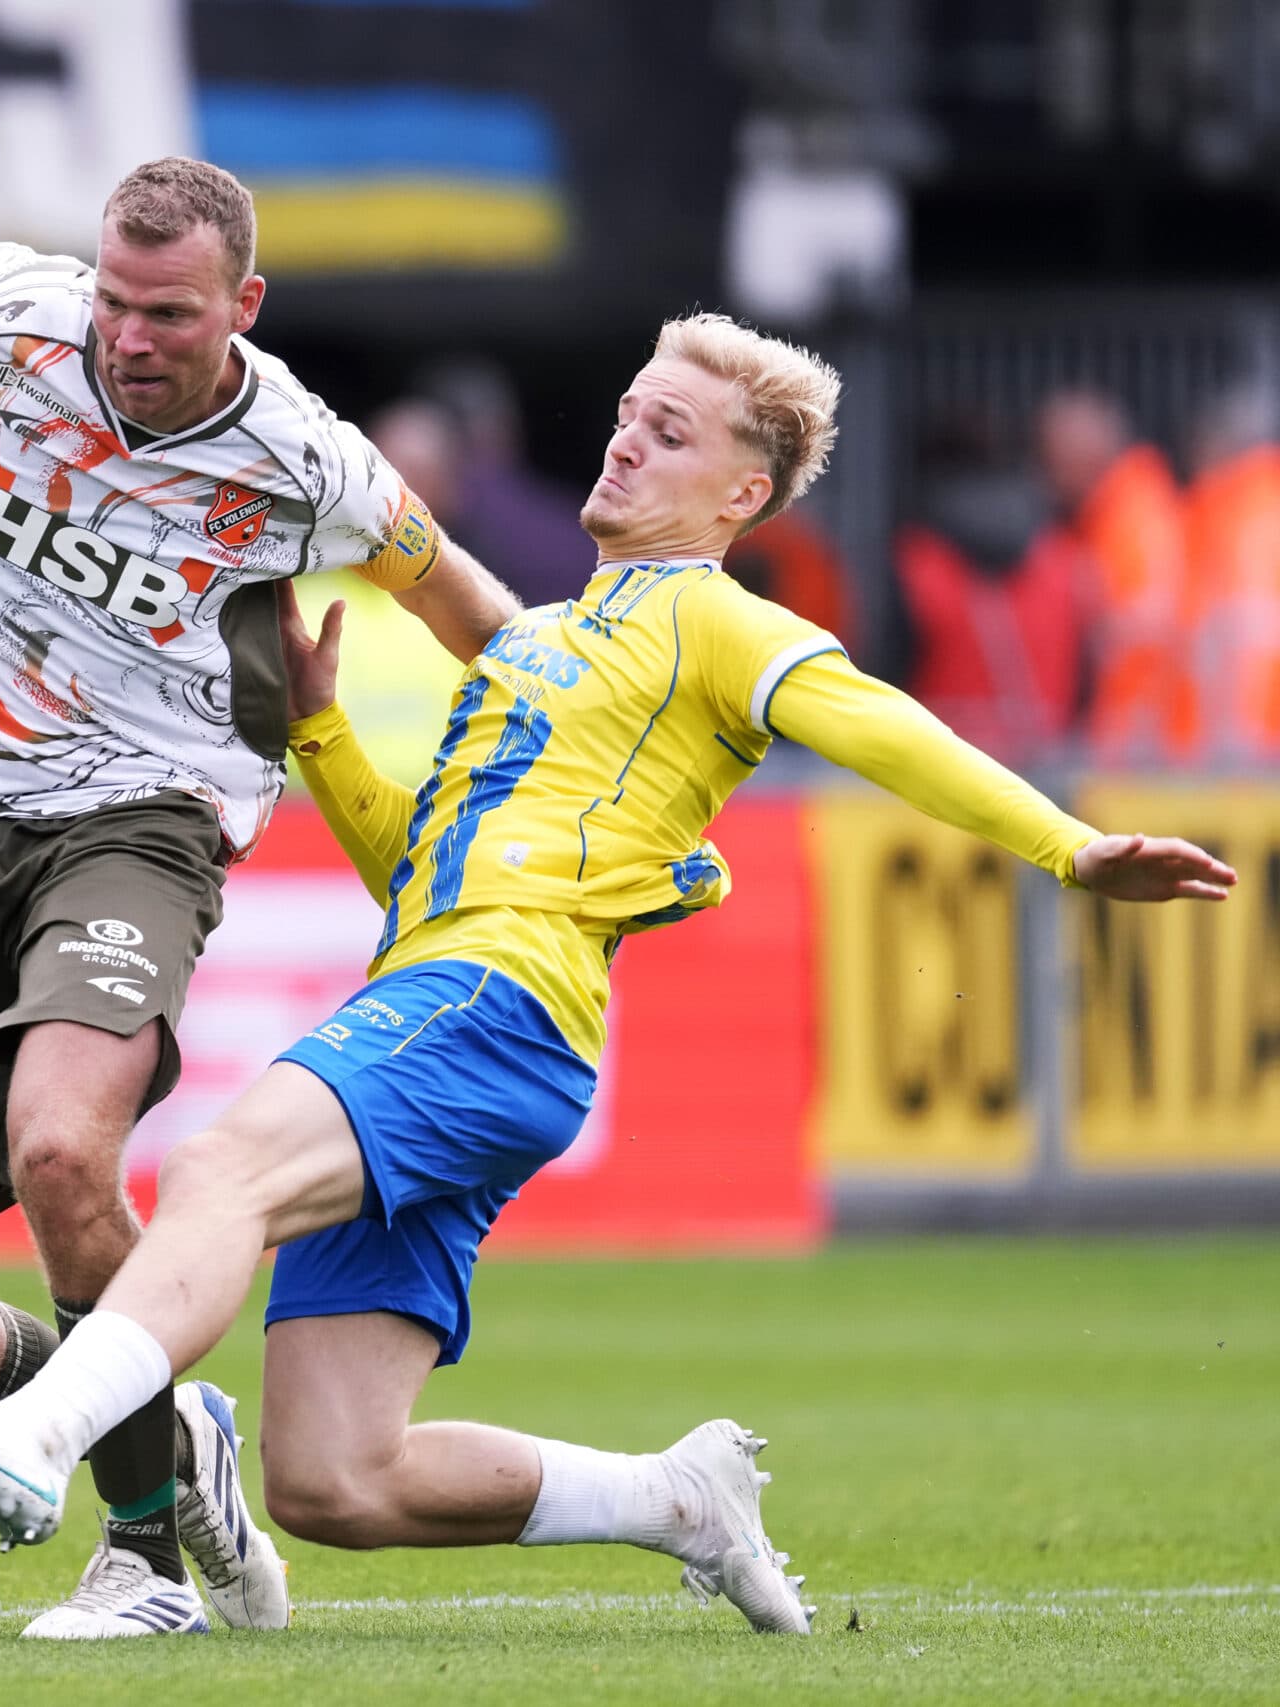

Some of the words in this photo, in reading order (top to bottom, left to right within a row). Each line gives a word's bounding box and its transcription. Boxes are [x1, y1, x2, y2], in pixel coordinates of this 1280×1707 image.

[16, 376, 81, 426] kwakman
[207, 521, 222, 534] FC
[222, 496, 273, 527] VOLENDAM
[58, 941, 158, 977] BRASPENNING
[82, 954, 128, 968] GROUP
